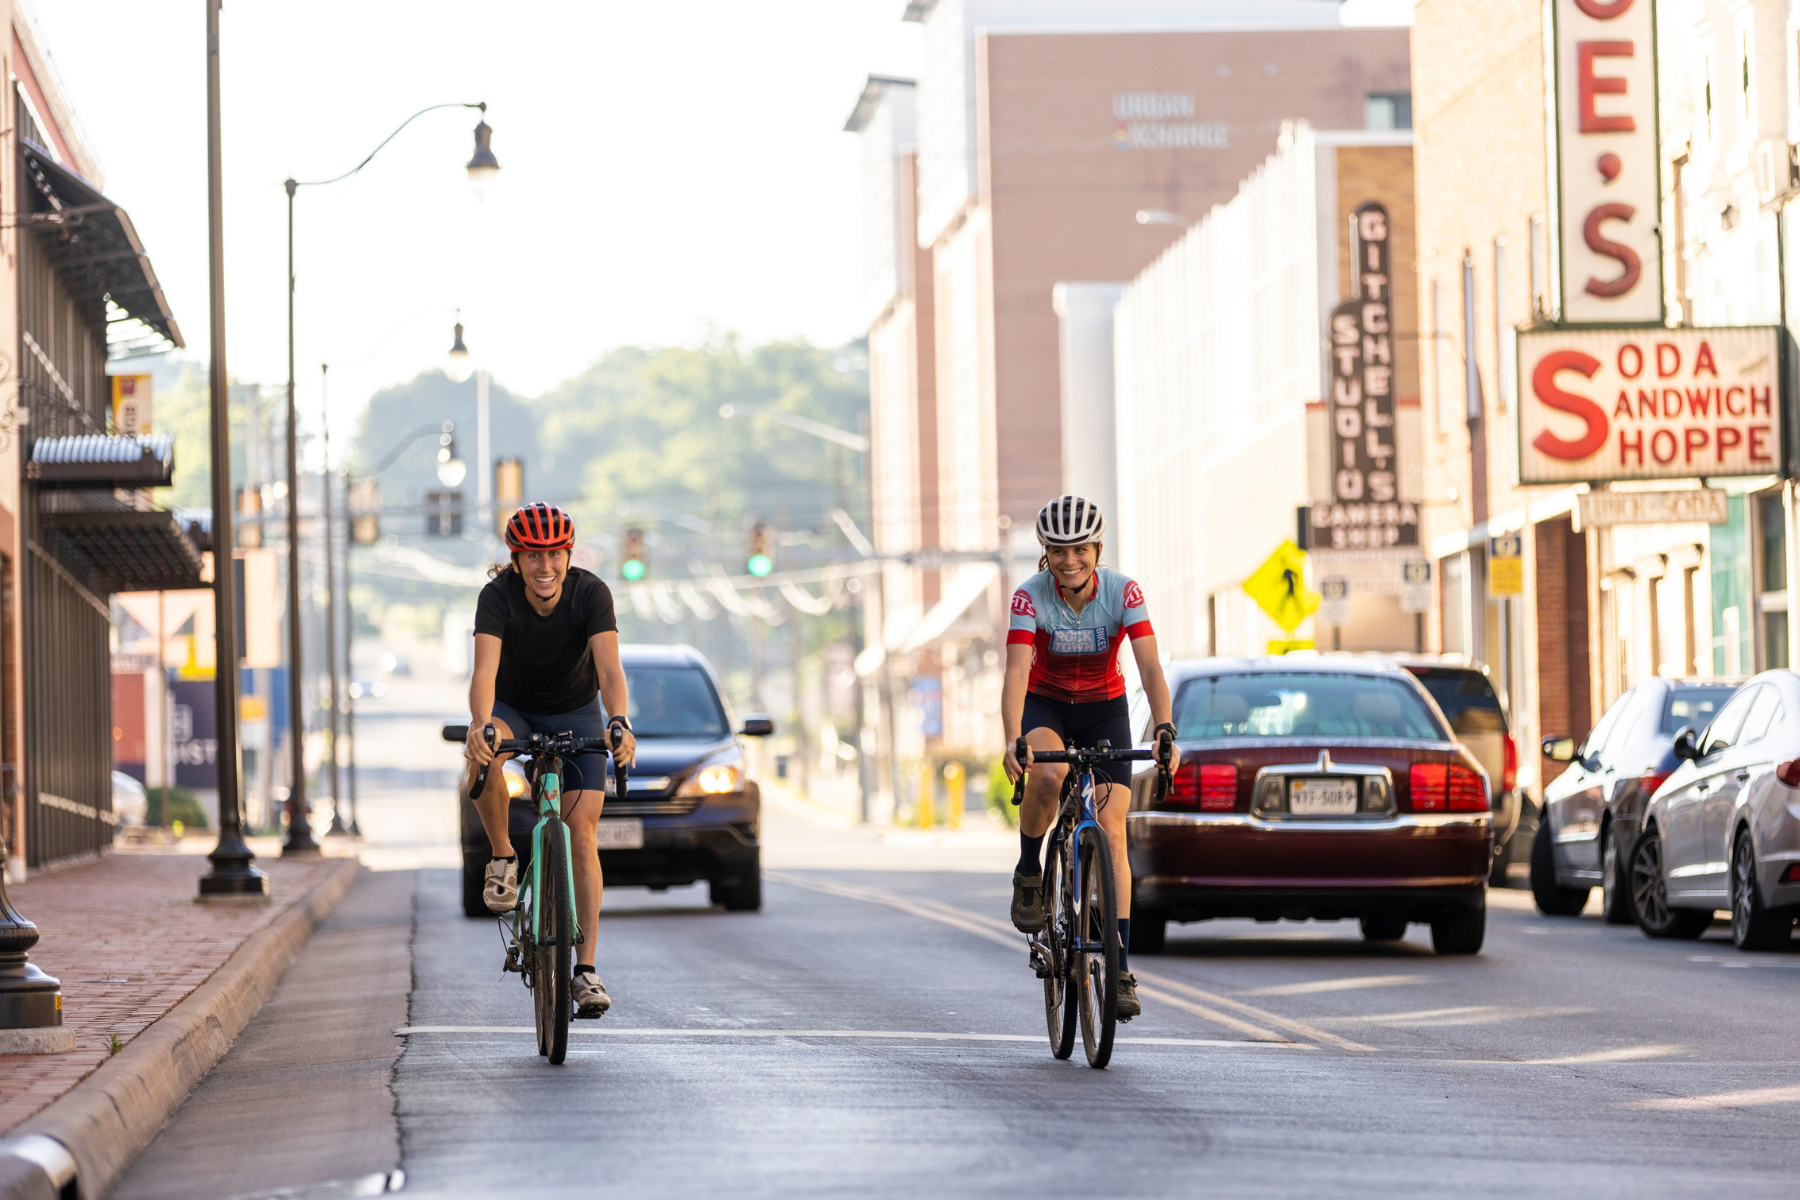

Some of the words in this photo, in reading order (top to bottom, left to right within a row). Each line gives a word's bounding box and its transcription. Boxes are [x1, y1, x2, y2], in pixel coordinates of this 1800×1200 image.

[1112, 91, 1195, 120] URBAN
[1055, 630, 1093, 642] ROCK
[1096, 627, 1107, 651] BIKES
[1055, 641, 1096, 652] TOWN
